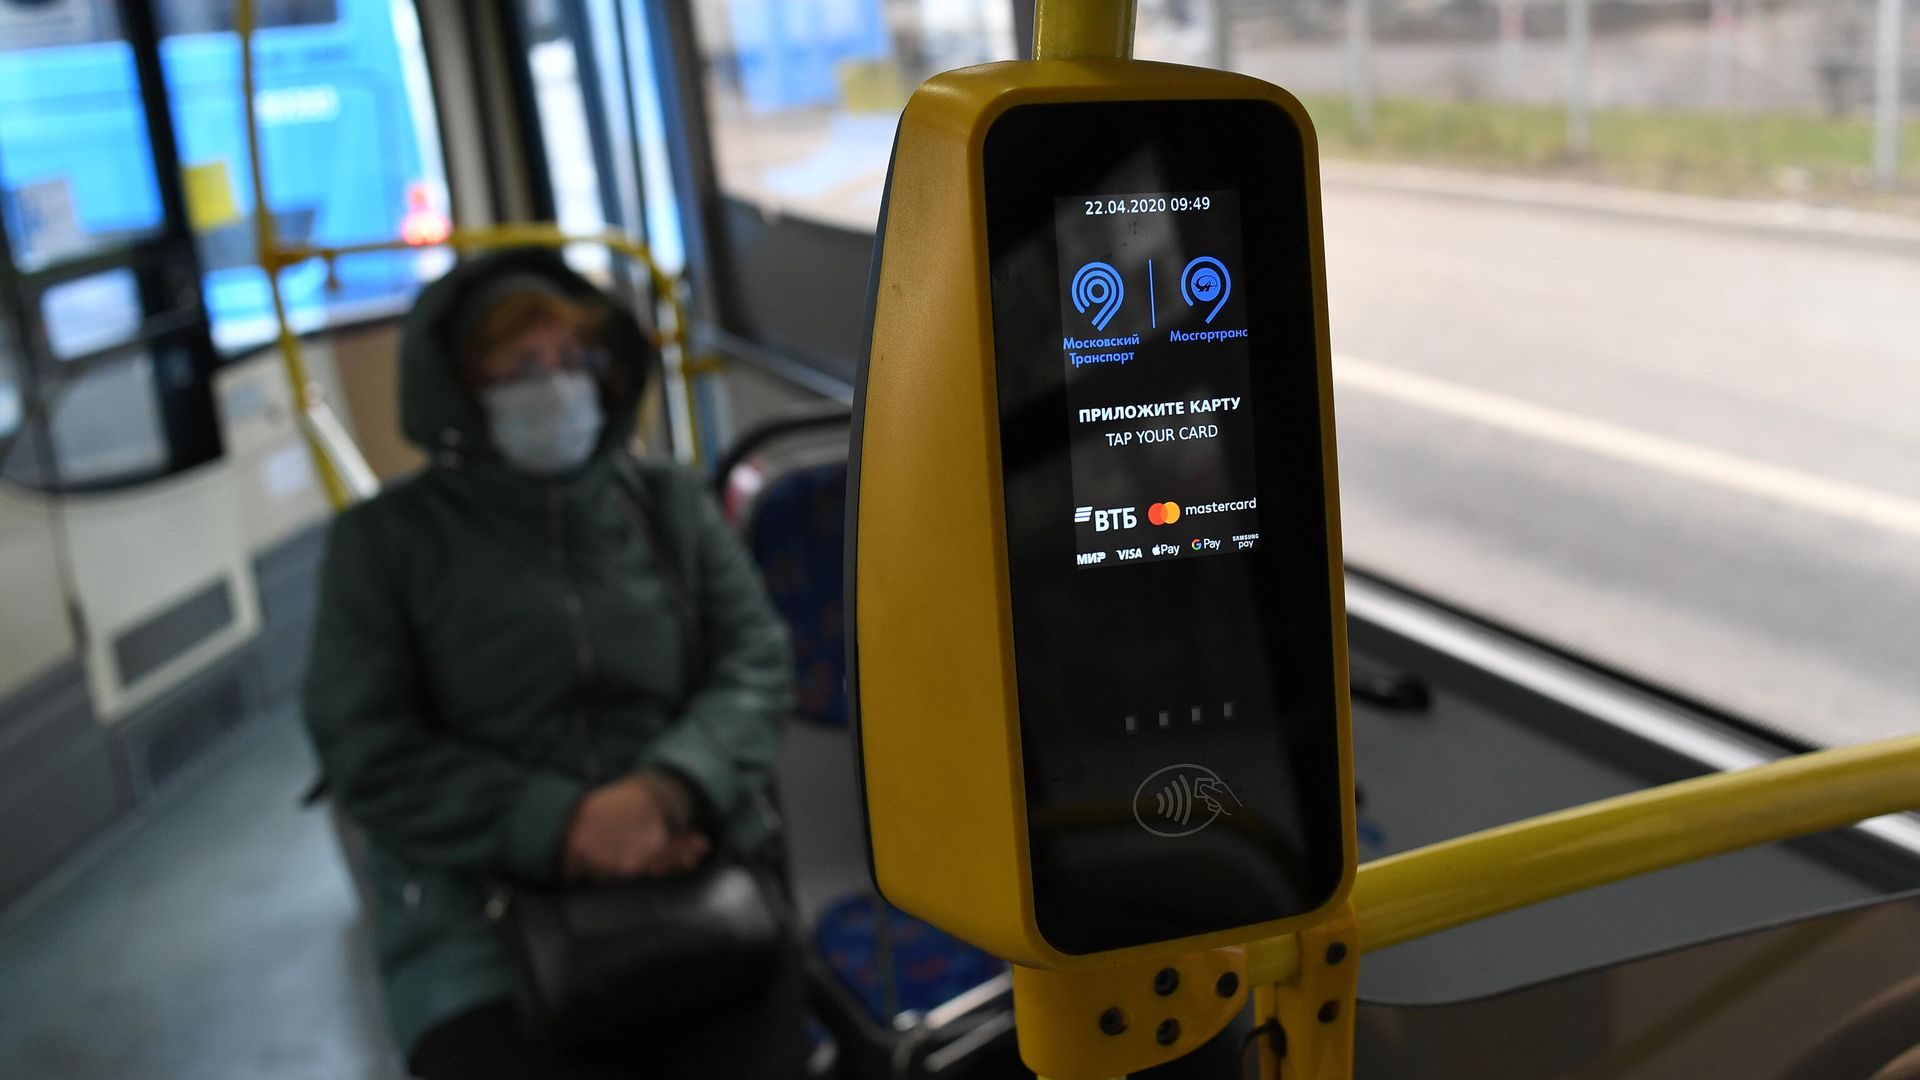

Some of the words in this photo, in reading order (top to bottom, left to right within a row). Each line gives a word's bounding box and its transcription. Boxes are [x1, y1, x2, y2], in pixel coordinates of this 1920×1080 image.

[1085, 198, 1166, 216] 22.04.2020
[1170, 196, 1211, 212] 09:49
[1063, 334, 1140, 350] Московский
[1170, 328, 1249, 343] Мосгортранс
[1069, 352, 1135, 368] Транспорт
[1078, 401, 1185, 423] ПРИЛОЖИТЕ
[1190, 397, 1241, 414] КАРТУ
[1105, 432, 1132, 447] TAP
[1136, 428, 1175, 444] YOUR
[1179, 424, 1218, 440] CARD
[1185, 497, 1257, 516] mastercard
[1094, 506, 1138, 532] ВТБ
[1203, 538, 1221, 550] Pay
[1232, 533, 1259, 542] SAMSUNG
[1238, 539, 1254, 550] pay
[1116, 548, 1143, 561] VISA
[1160, 544, 1180, 556] Pay
[1076, 551, 1107, 566] МИР
